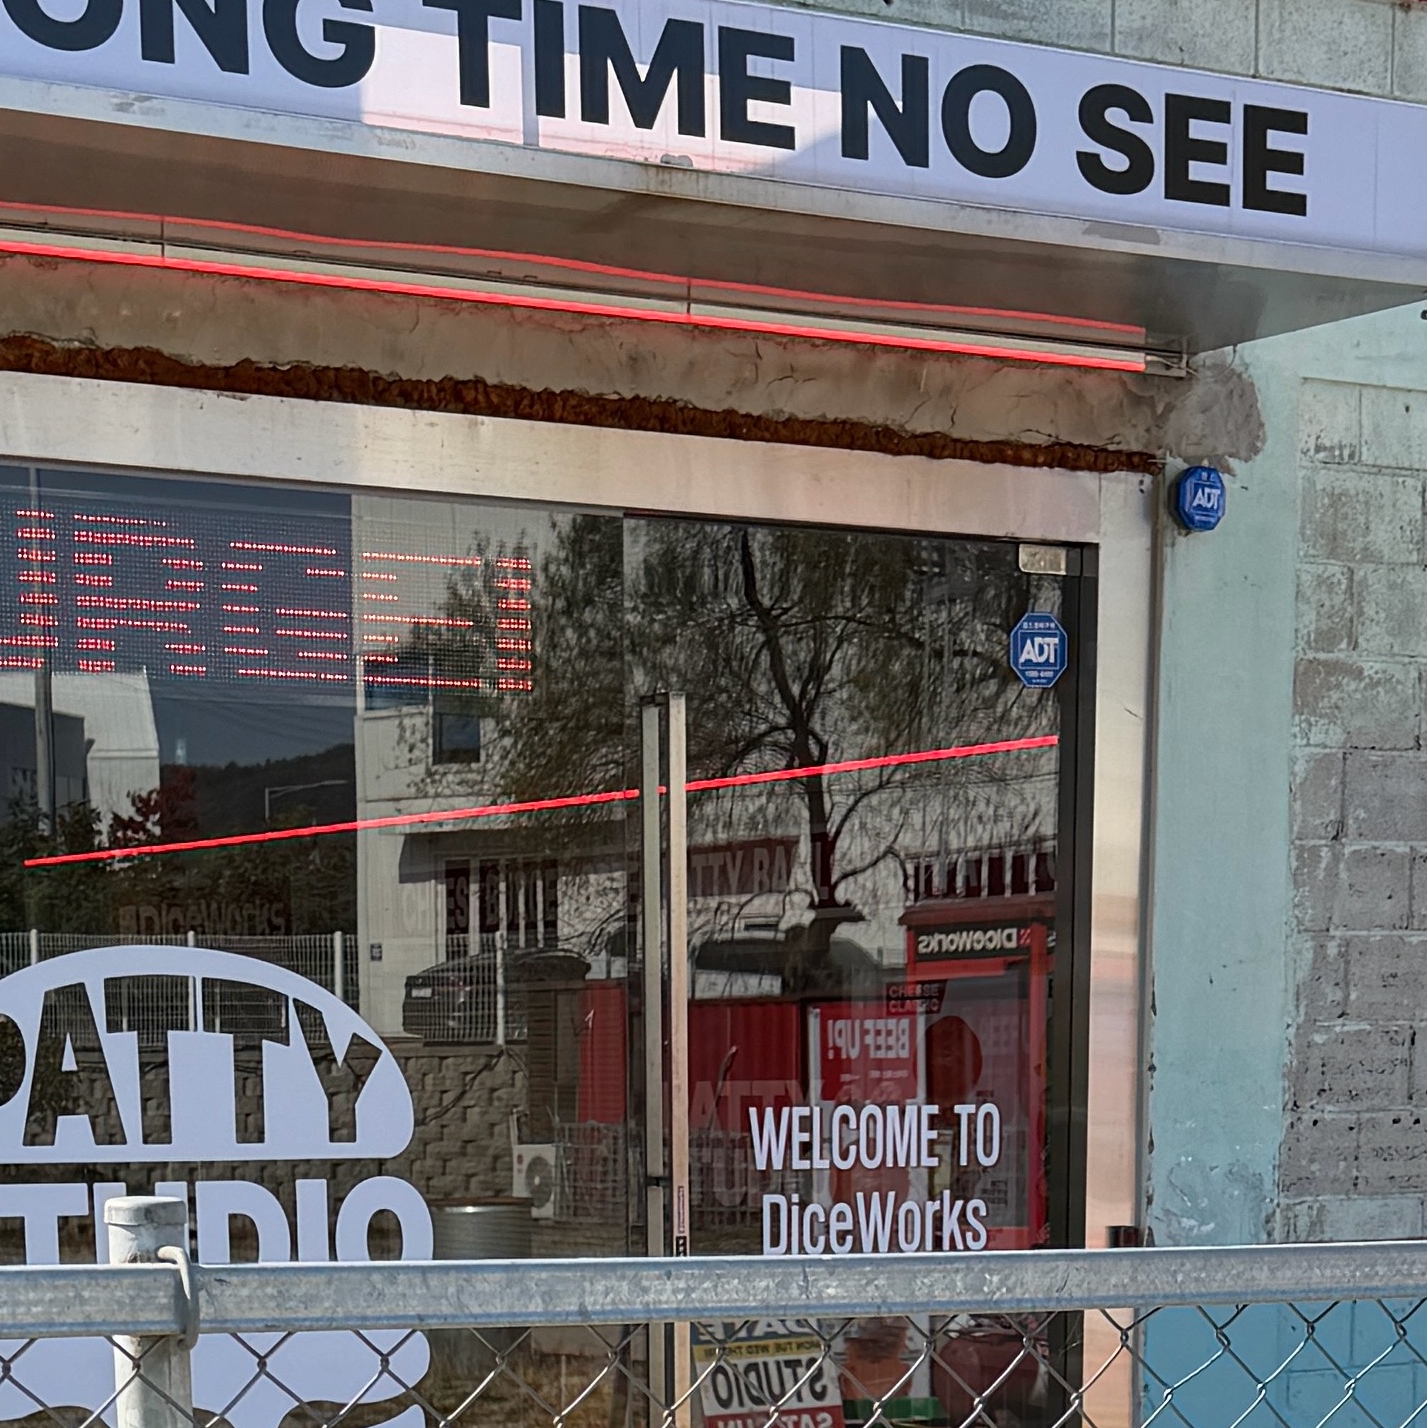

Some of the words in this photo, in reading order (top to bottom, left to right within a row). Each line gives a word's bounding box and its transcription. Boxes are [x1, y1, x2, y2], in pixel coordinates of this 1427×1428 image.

[422, 0, 795, 151] TIME
[839, 45, 1037, 179] NO
[1076, 83, 1308, 217] SEE
[1192, 487, 1221, 510] ADT
[1018, 636, 1059, 663] ADT
[748, 1104, 939, 1170] WELCOME
[954, 1103, 1001, 1167] TO
[763, 1190, 987, 1255] DiceWorks
